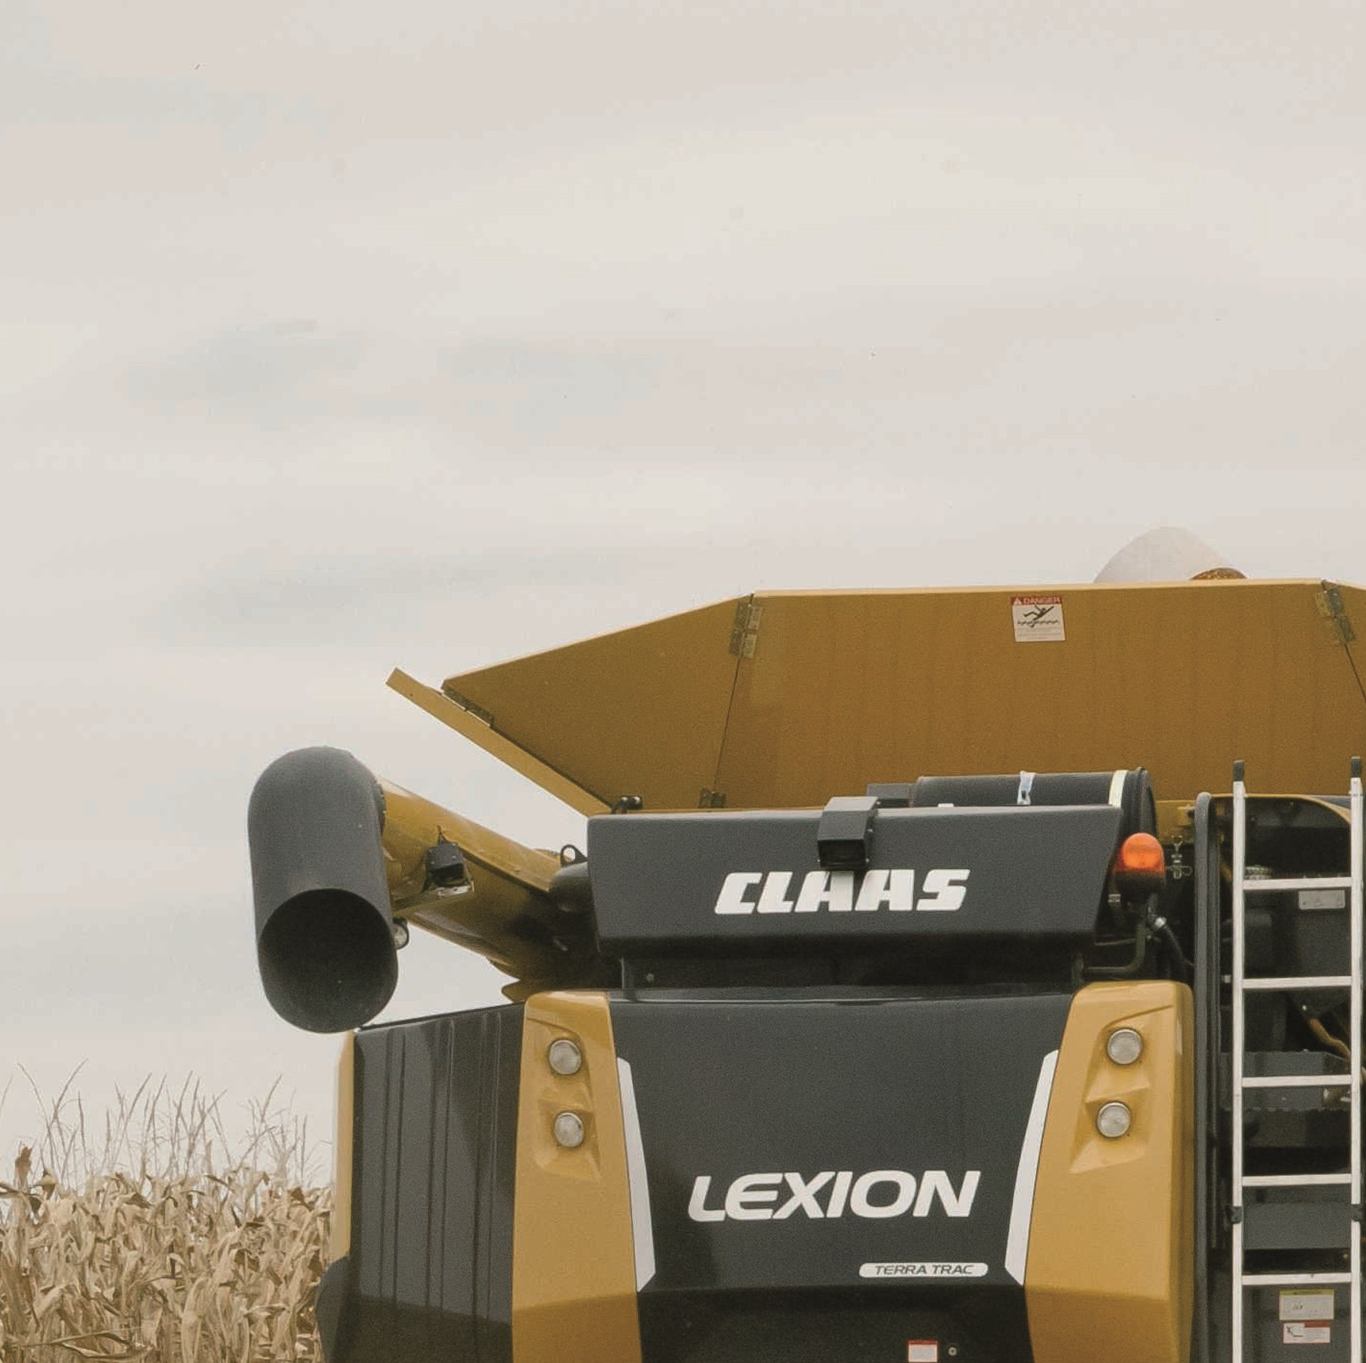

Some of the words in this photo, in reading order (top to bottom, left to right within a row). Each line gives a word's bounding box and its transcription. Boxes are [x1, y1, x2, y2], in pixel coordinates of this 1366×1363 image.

[714, 869, 971, 914] CLAAS
[688, 1170, 981, 1222] LEXION
[875, 1264, 927, 1275] TERRA
[932, 1264, 975, 1275] TRAC
